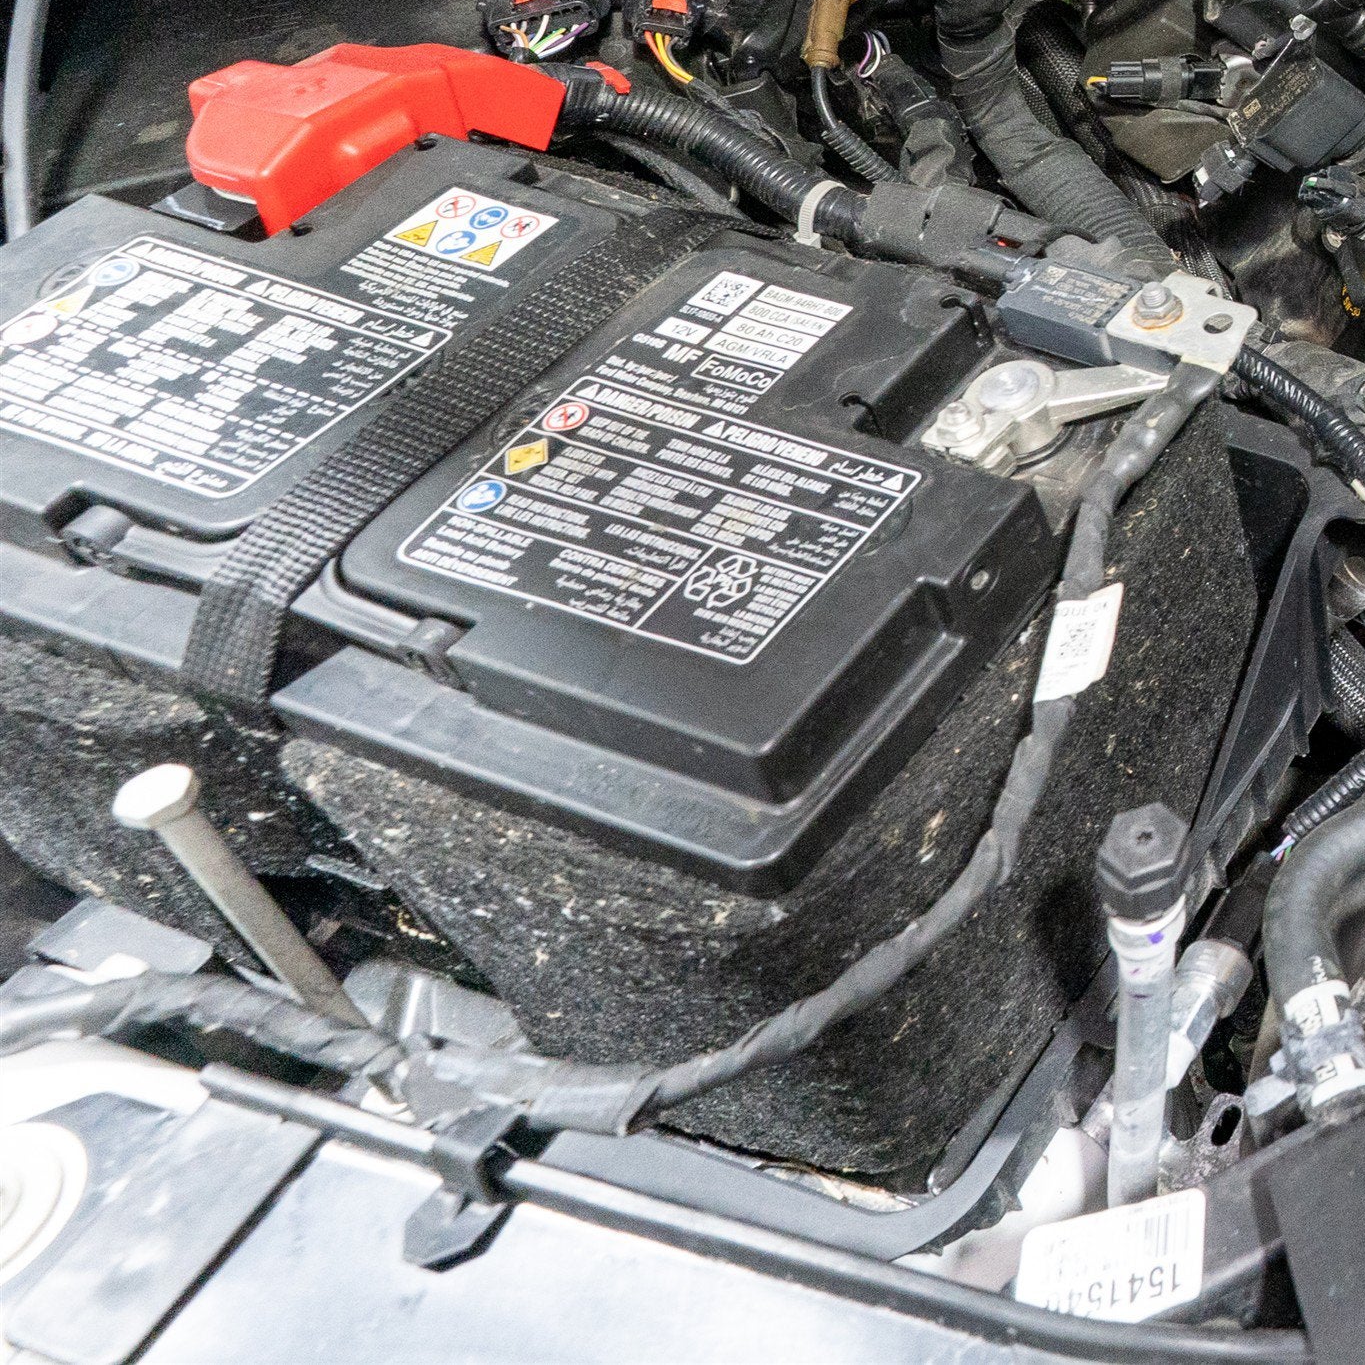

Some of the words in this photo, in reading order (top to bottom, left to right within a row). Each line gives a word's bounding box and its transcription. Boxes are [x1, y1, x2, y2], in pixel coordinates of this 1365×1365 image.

[748, 305, 769, 317] 800
[768, 311, 790, 323] CCA
[670, 324, 698, 337] 12V
[736, 322, 756, 333] 80
[754, 328, 776, 339] Ah
[776, 333, 804, 347] C20
[662, 344, 704, 363] MF
[715, 338, 789, 364] AGM/VRLA
[700, 361, 773, 389] FoMoCo
